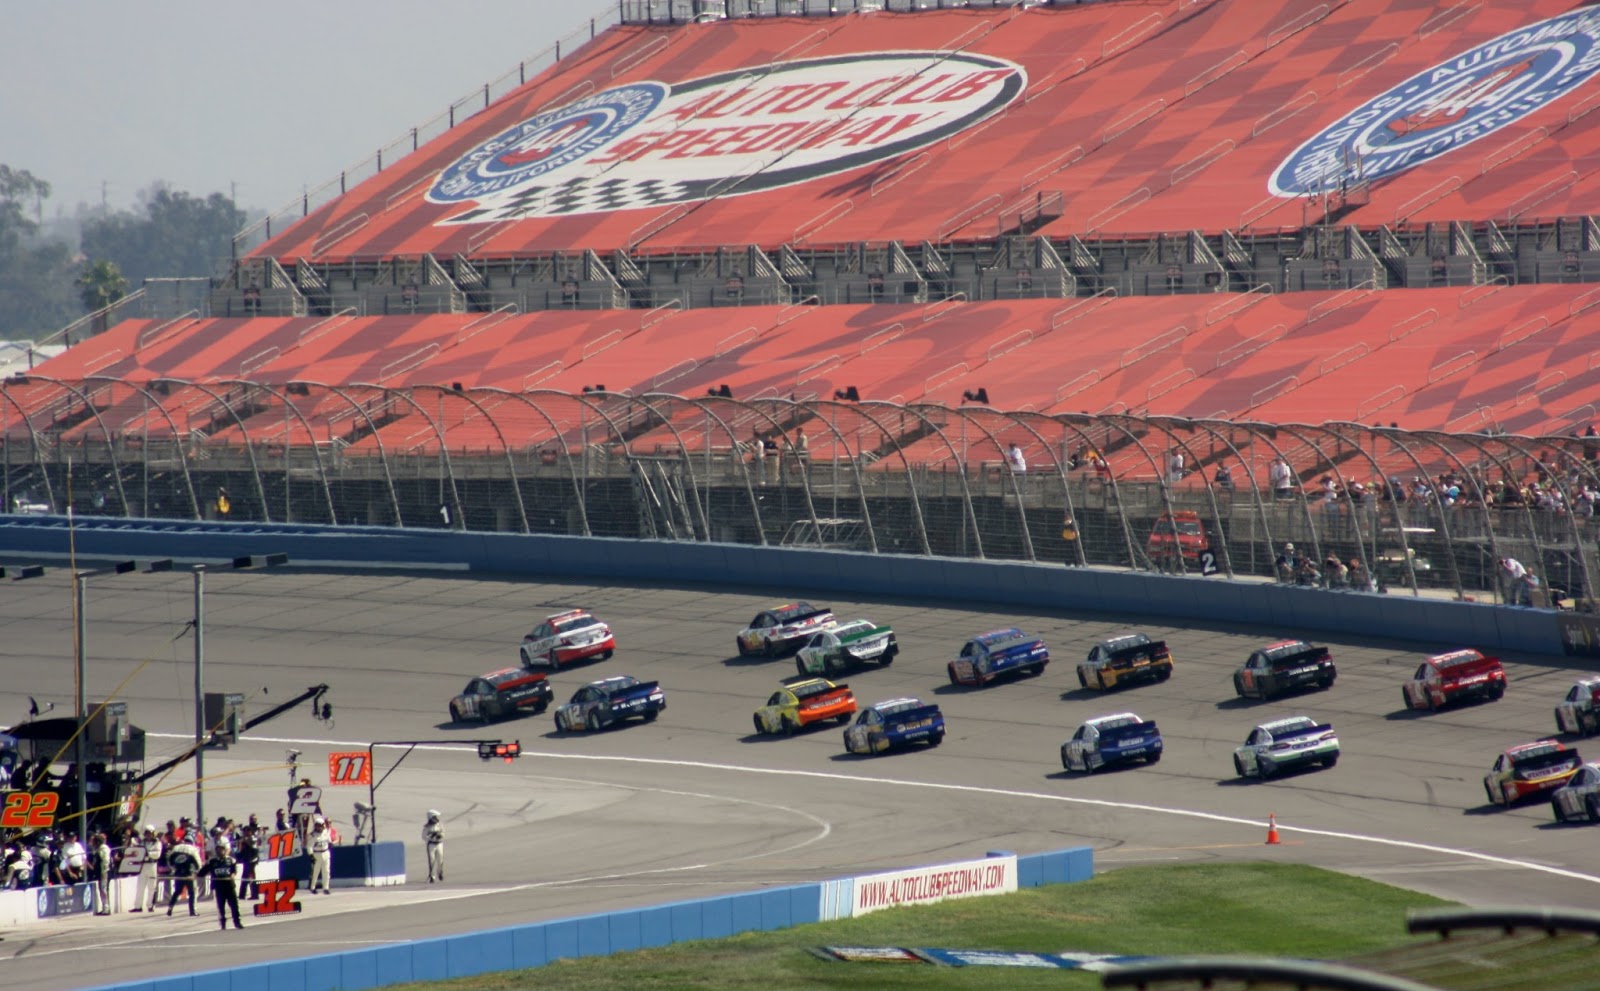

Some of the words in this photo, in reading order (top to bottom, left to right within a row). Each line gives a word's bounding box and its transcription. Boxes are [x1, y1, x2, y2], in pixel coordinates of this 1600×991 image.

[644, 81, 850, 124] AUTO
[824, 68, 1016, 110] CLUB
[1406, 69, 1536, 116] AAA
[510, 123, 593, 154] AAA
[584, 111, 946, 164] SPEEDWAY
[1202, 552, 1217, 573] 2
[335, 756, 366, 781] 11
[0, 791, 60, 828] 22
[290, 787, 322, 814] 2
[118, 846, 146, 874] 2
[267, 830, 296, 860] 11
[257, 880, 298, 915] 32
[859, 864, 1006, 909] WWW.AUTOCLUBSPEEDWAY.COM
